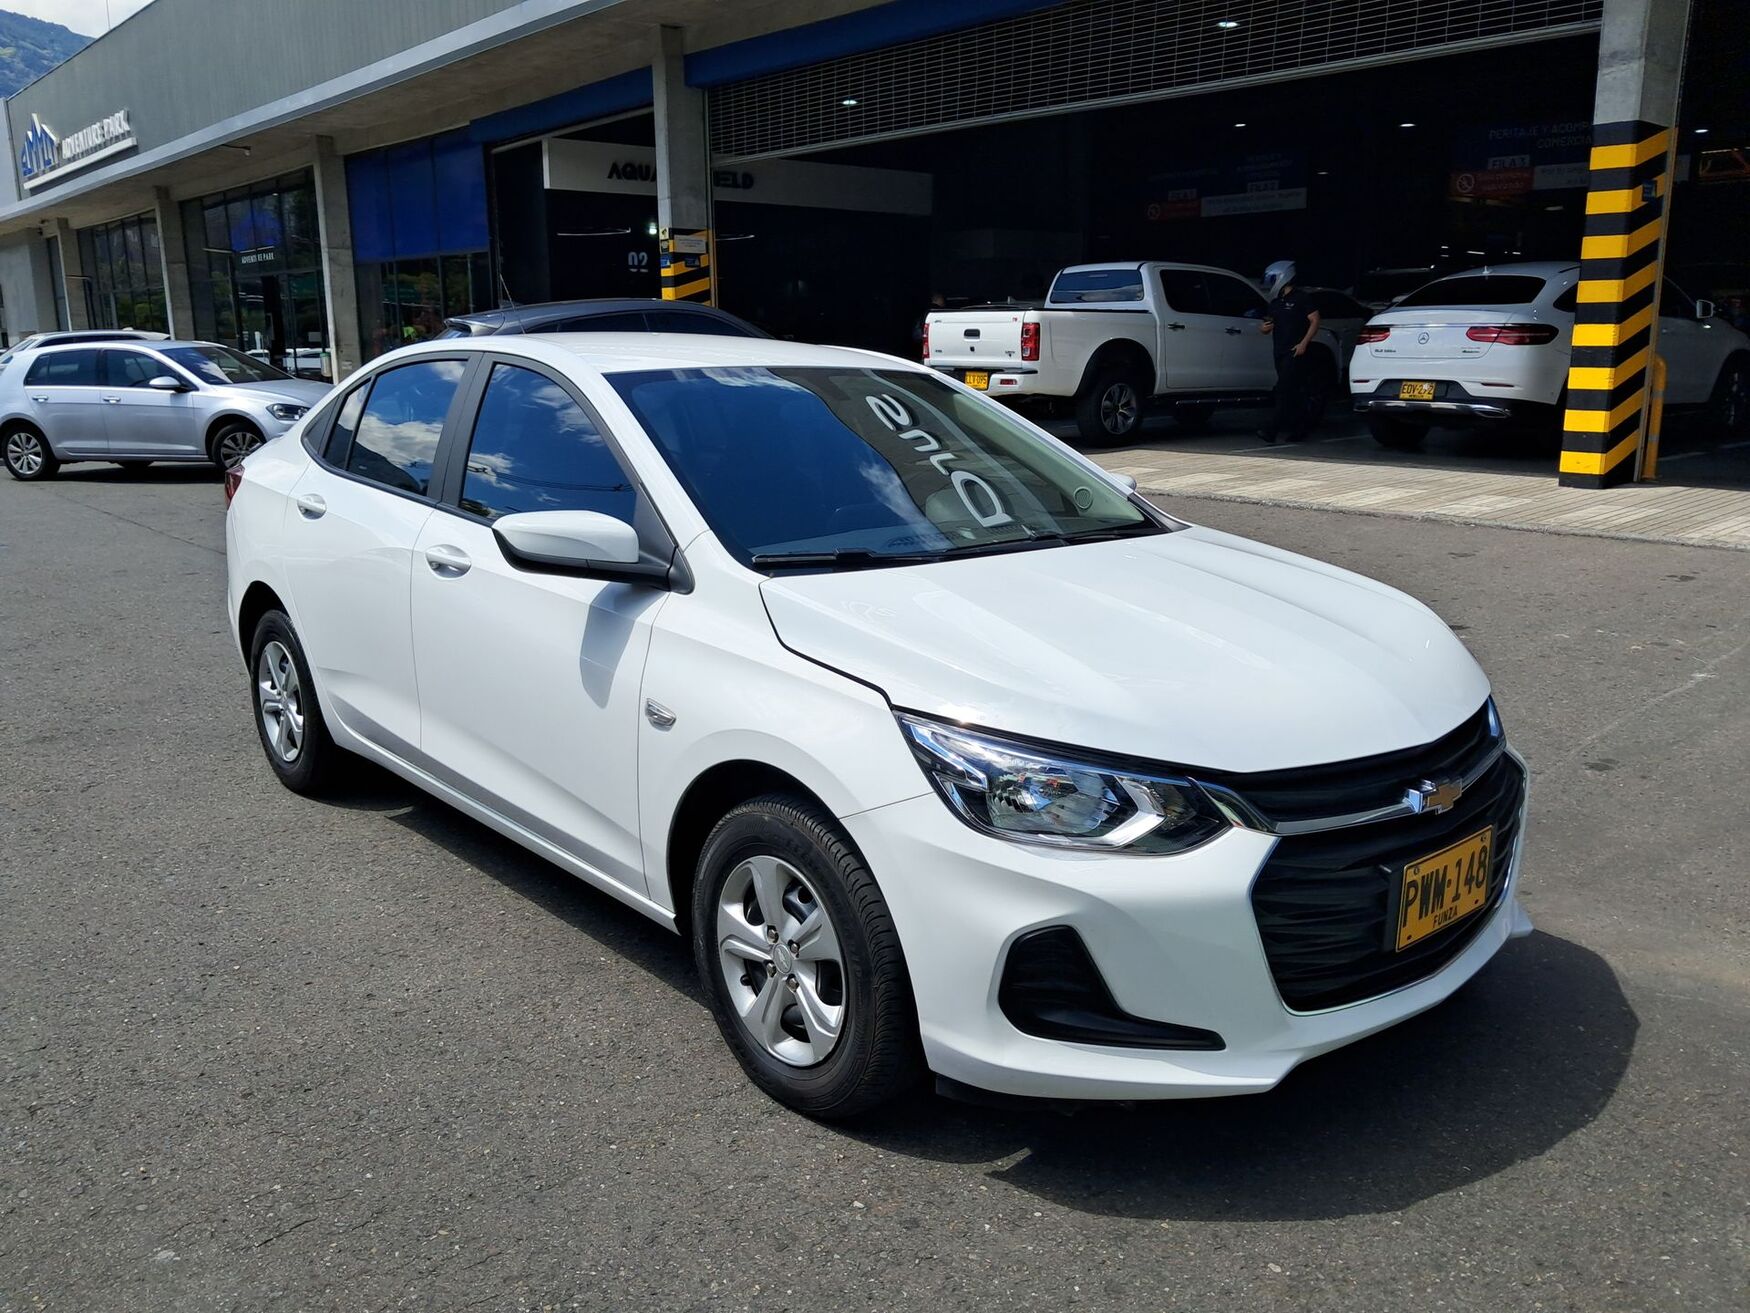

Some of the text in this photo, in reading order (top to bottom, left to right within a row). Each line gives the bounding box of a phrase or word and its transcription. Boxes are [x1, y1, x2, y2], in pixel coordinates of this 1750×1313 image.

[103, 109, 131, 139] PARK
[628, 251, 649, 273] 02
[1433, 905, 1459, 929] FUNZA
